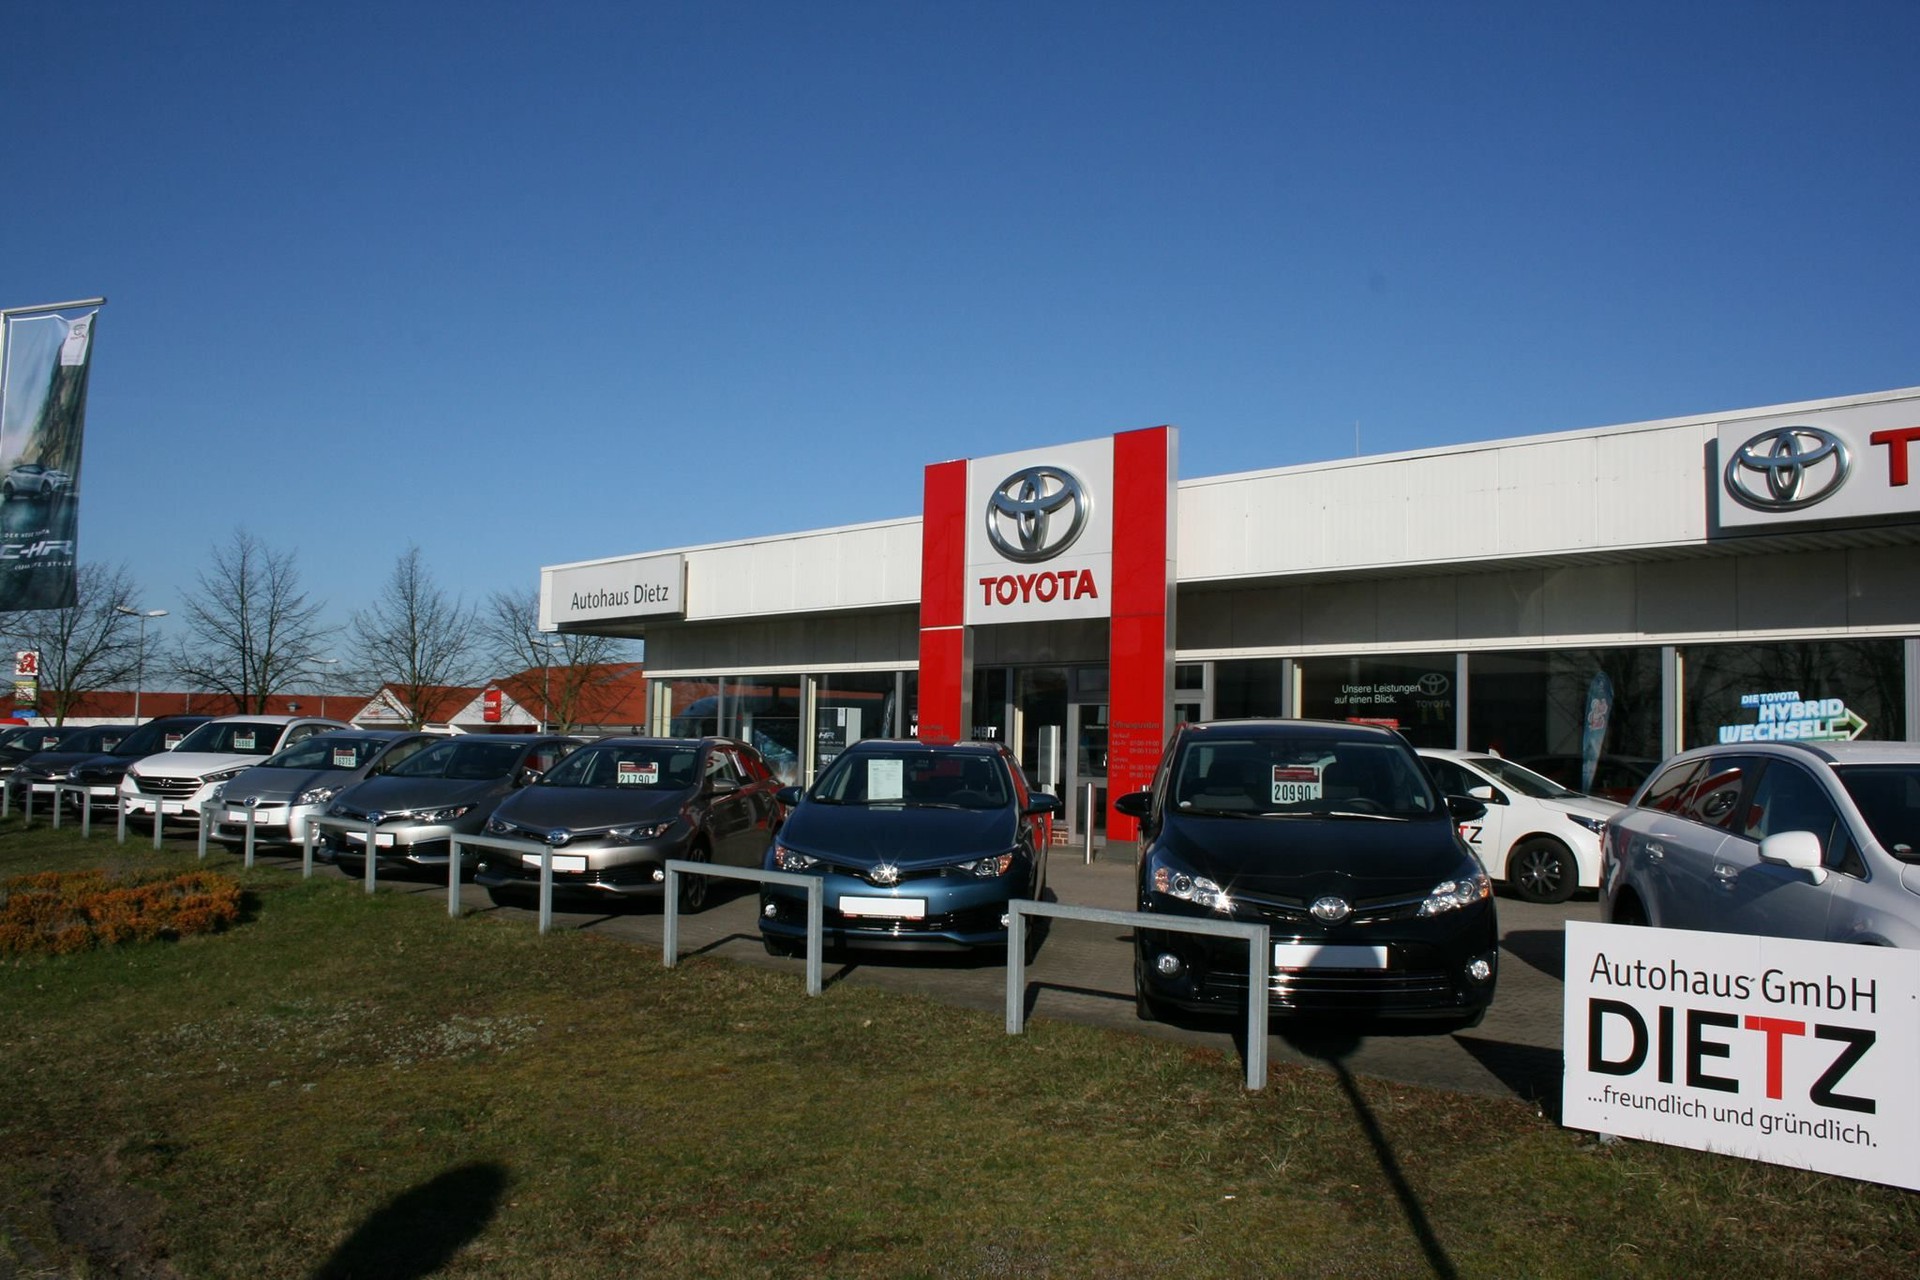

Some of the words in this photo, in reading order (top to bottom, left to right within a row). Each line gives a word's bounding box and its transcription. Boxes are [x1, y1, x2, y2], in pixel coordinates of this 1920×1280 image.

[1870, 426, 1920, 488] T
[571, 588, 629, 610] Autohaus
[634, 583, 669, 604] Dietz
[979, 569, 1098, 606] TOYOTA
[1335, 695, 1347, 704] auf
[1349, 694, 1372, 704] einen
[1374, 693, 1397, 704] Blick.
[1342, 684, 1372, 694] Unsere
[1374, 684, 1421, 695] Leistungen
[1741, 695, 1759, 705] DIE
[1760, 691, 1800, 703] TOYOTA
[1416, 700, 1451, 709] TOYOTA
[1759, 699, 1844, 722] HYBRID
[1719, 719, 1831, 744] WECHSEL
[620, 775, 650, 783] 21790
[1275, 785, 1311, 801] 20990
[1590, 953, 1750, 999] Autohaus
[1762, 968, 1876, 1013] GmbH
[1588, 997, 1876, 1115] DIETZ
[1588, 1085, 1706, 1119] ...freundlich
[1713, 1108, 1753, 1126] und
[1760, 1113, 1877, 1148] gründlich.
